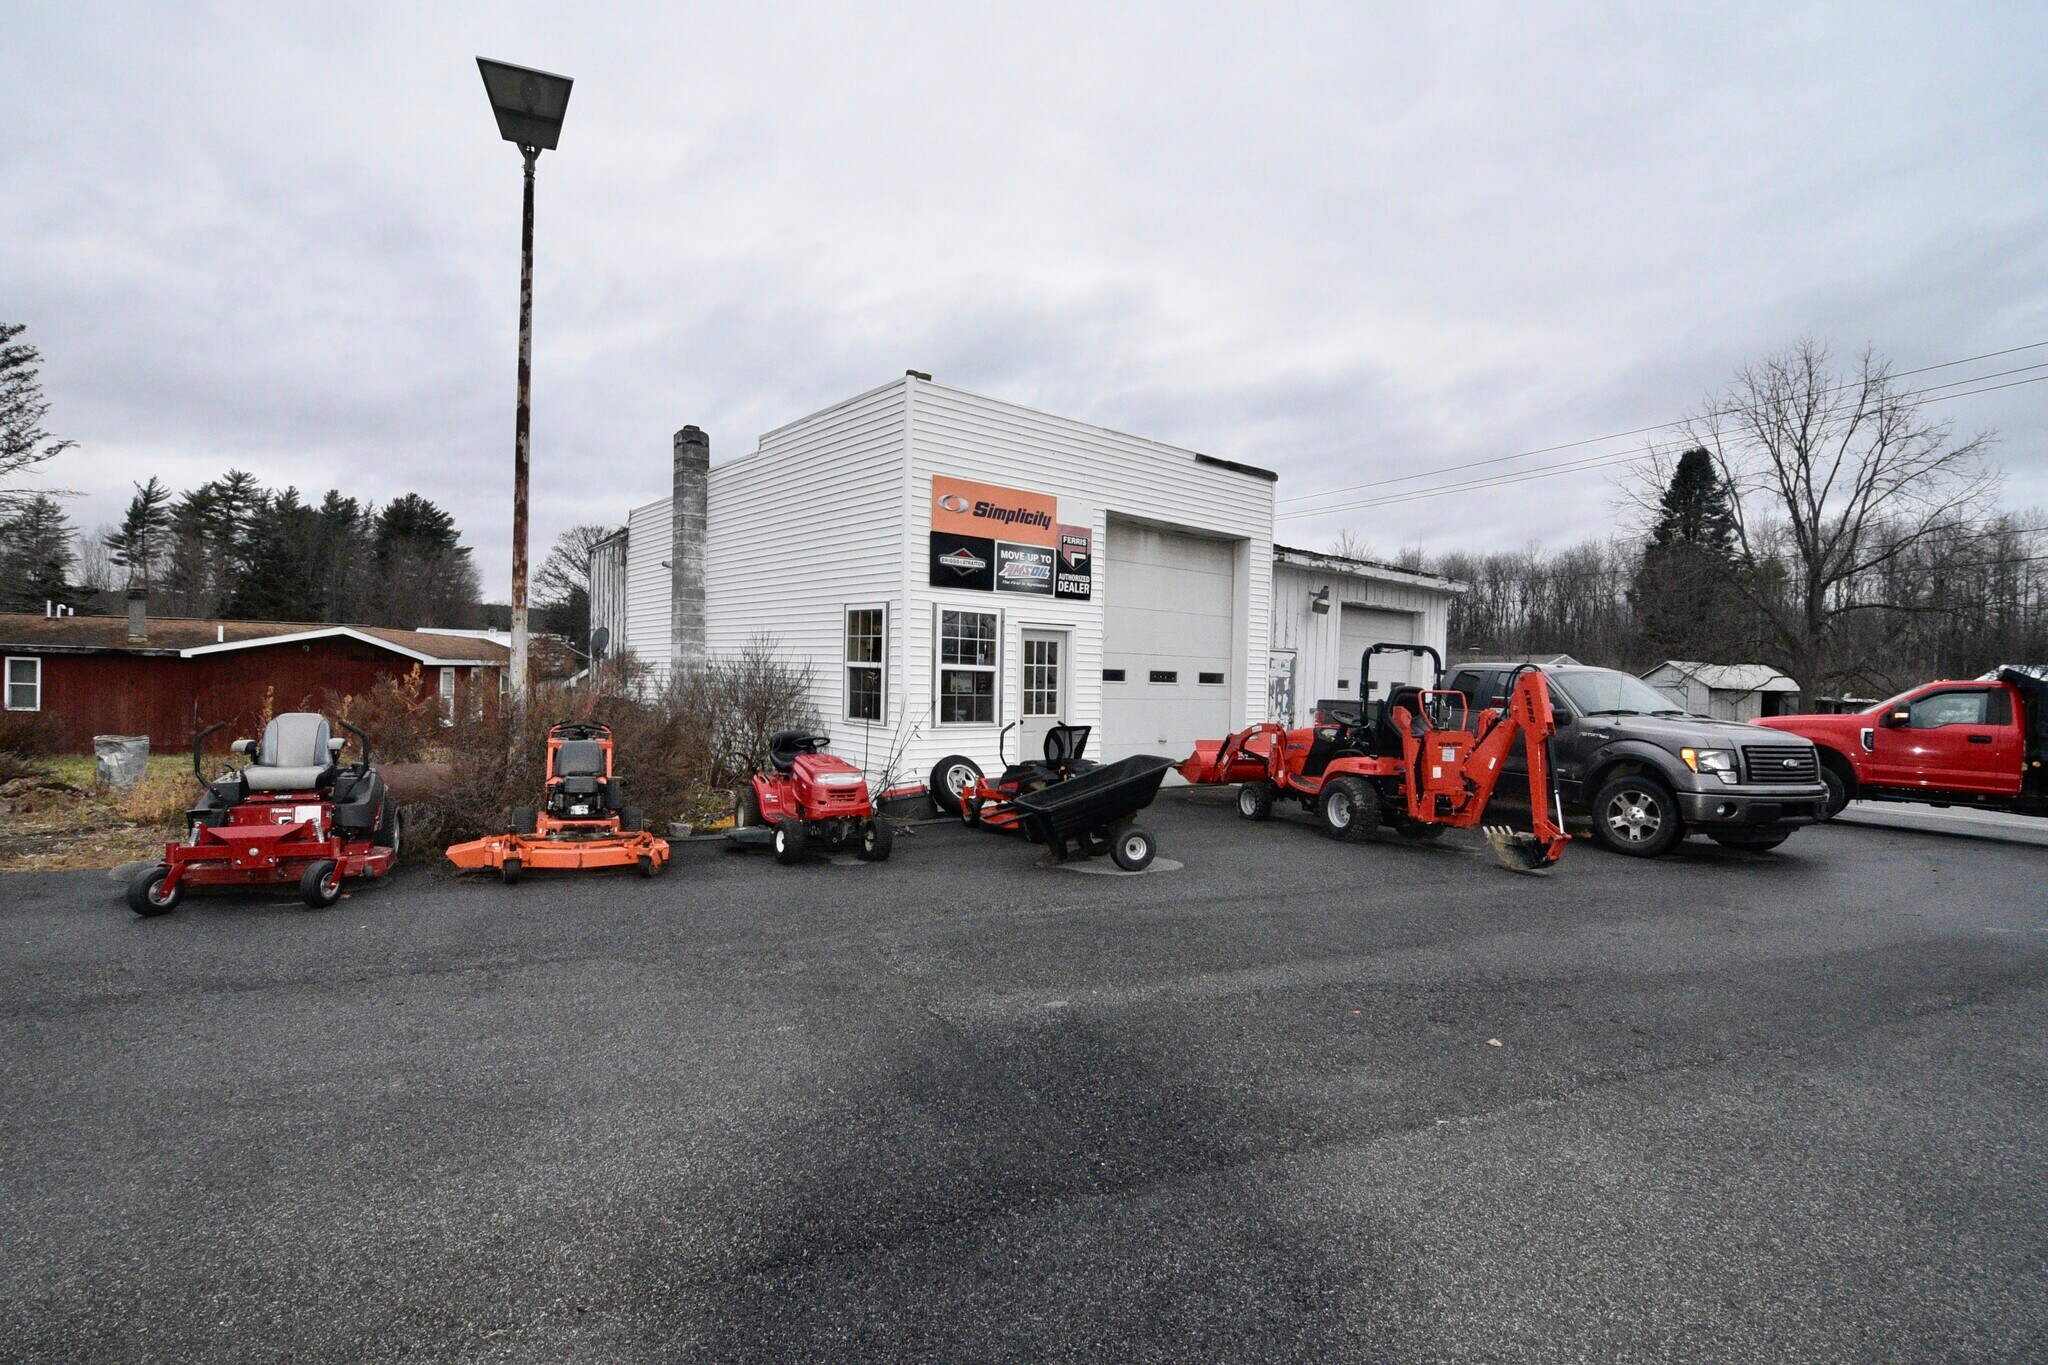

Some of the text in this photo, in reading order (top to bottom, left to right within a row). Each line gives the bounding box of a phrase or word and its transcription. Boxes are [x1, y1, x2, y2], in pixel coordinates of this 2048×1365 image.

[972, 501, 1052, 530] Simplicity
[1062, 536, 1087, 546] FERRIS
[1000, 549, 1052, 564] MOVE UP TO
[999, 562, 1050, 579] AMSOIL
[1058, 572, 1090, 583] AUTHORIZED
[1057, 580, 1090, 595] DEALER
